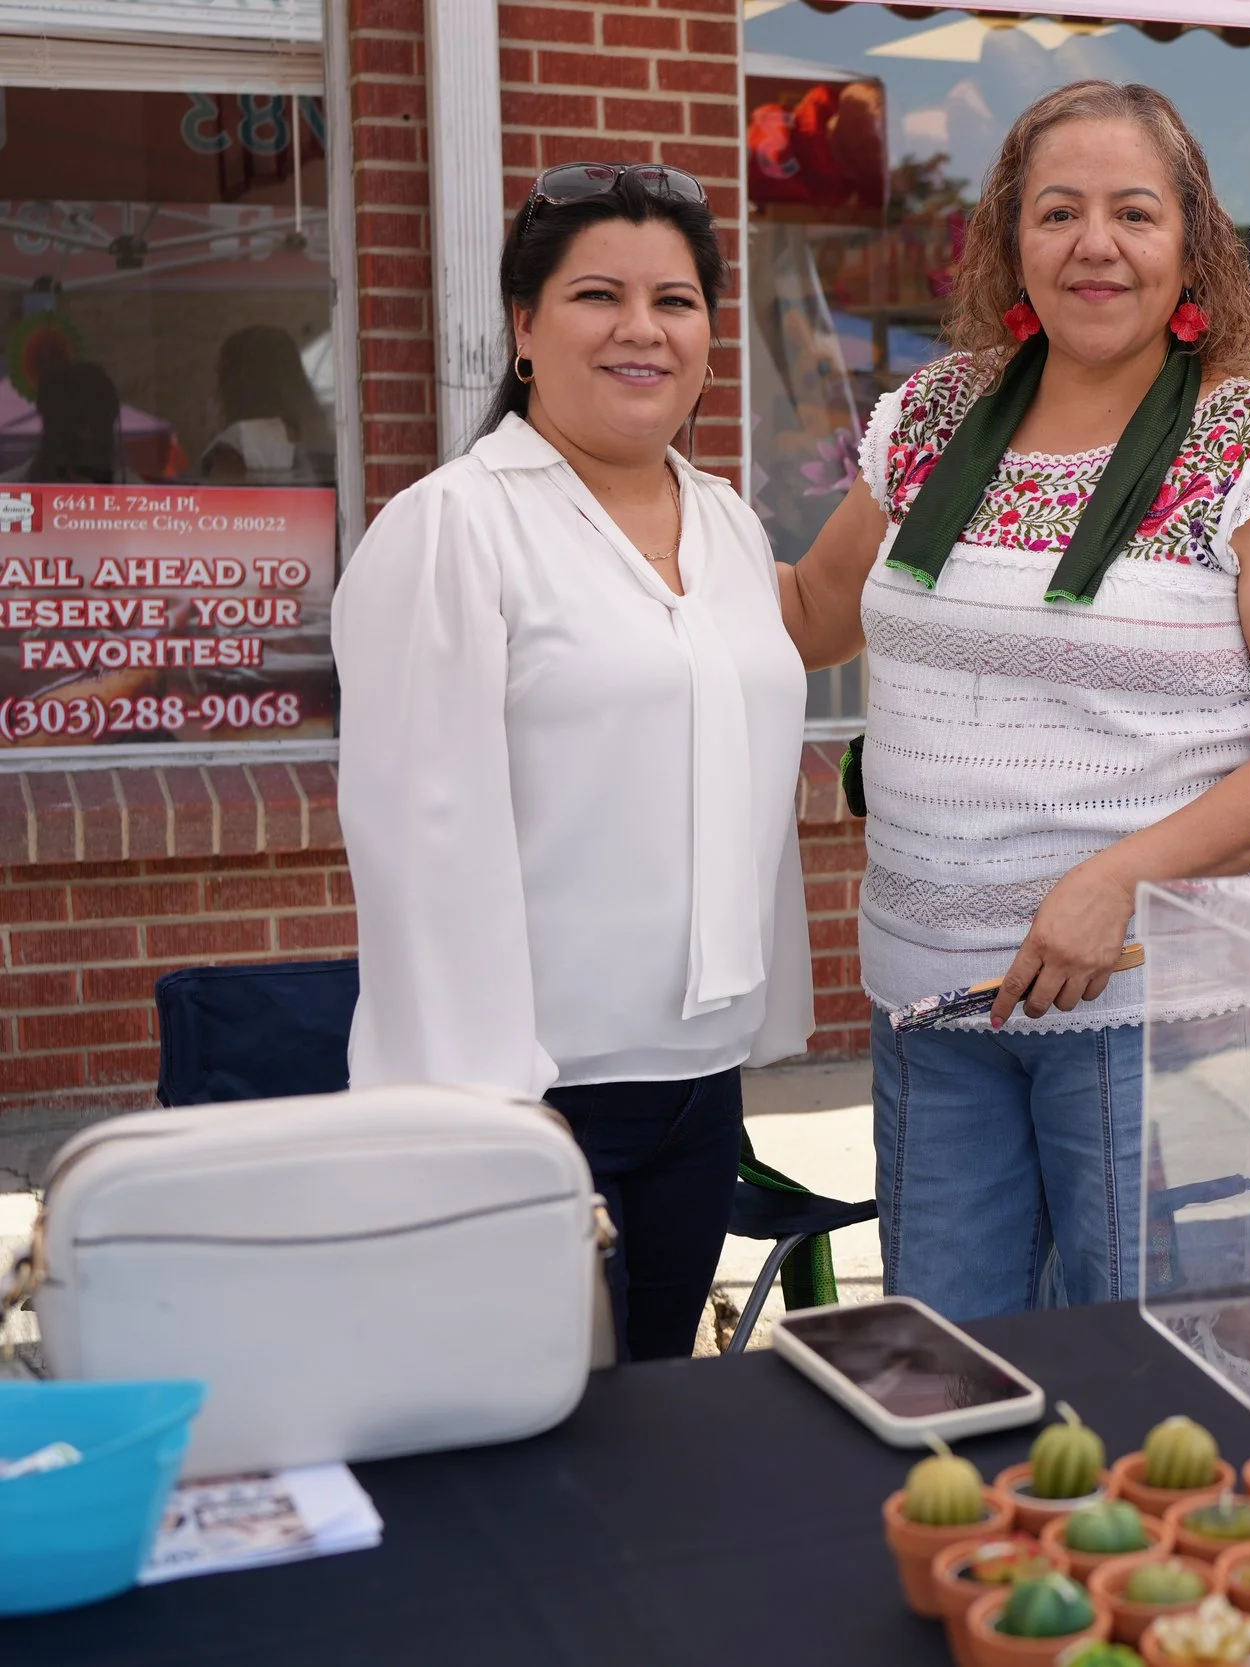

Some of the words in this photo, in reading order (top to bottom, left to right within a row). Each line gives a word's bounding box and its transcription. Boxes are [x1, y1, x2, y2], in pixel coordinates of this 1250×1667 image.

[53, 495, 96, 512] 6441
[103, 496, 121, 512] E.
[126, 496, 171, 512] 72nd
[176, 496, 201, 515] Pl,
[53, 514, 148, 531] Commerce
[152, 515, 193, 535] City,
[198, 516, 229, 531] CO
[233, 516, 287, 532] 80022
[0, 558, 81, 588] ALL
[94, 558, 244, 587] AHEAD
[254, 558, 308, 587] TO
[193, 599, 300, 627] YOUR
[22, 638, 262, 669] FAVORITES!!
[0, 692, 301, 740] (303)288-9068
